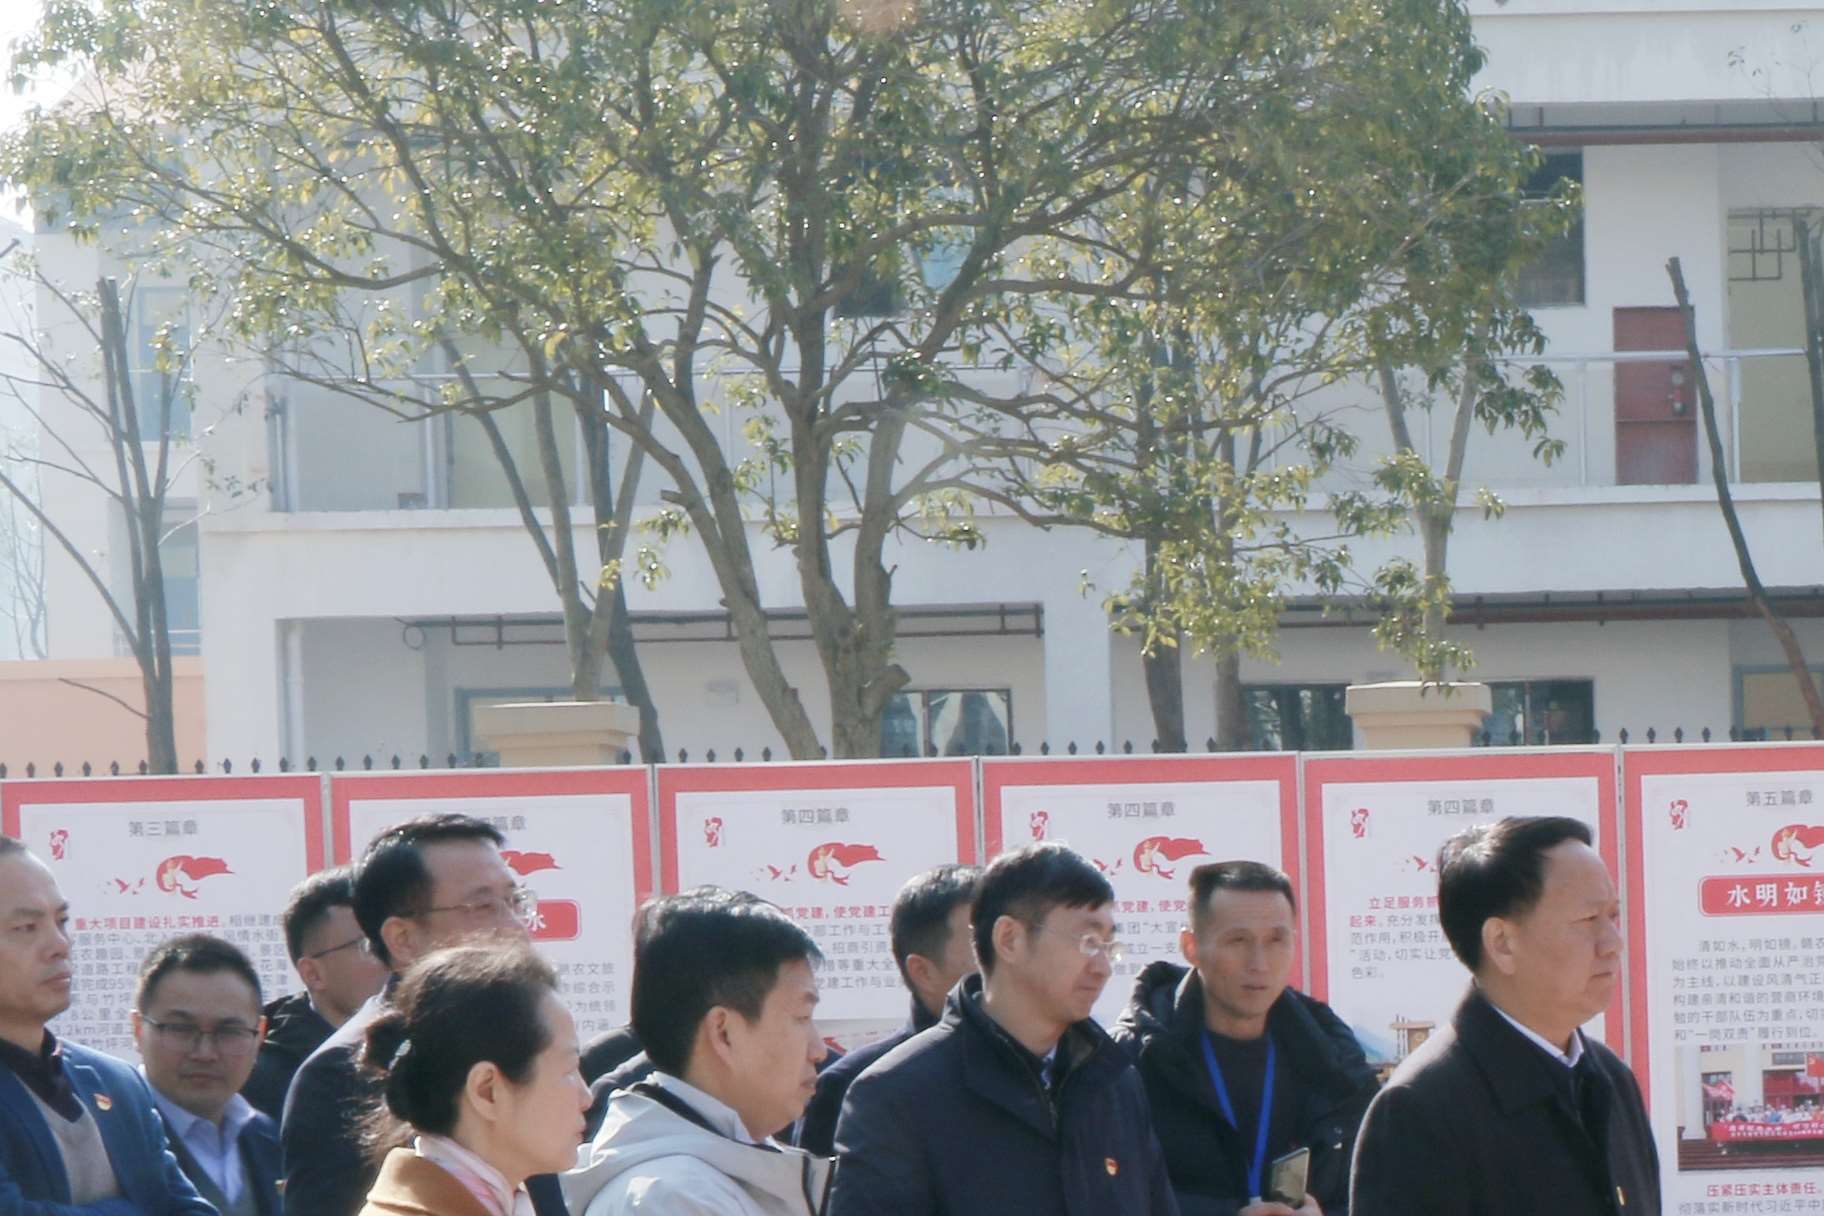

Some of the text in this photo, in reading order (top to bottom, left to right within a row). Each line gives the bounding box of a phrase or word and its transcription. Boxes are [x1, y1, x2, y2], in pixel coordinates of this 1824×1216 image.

[1746, 789, 1813, 807] 第五篇章
[1108, 802, 1175, 818] 第四篇章
[1428, 799, 1495, 815] 第四篇章
[781, 808, 849, 824] 第四篇章
[129, 820, 198, 837] 第三篇章
